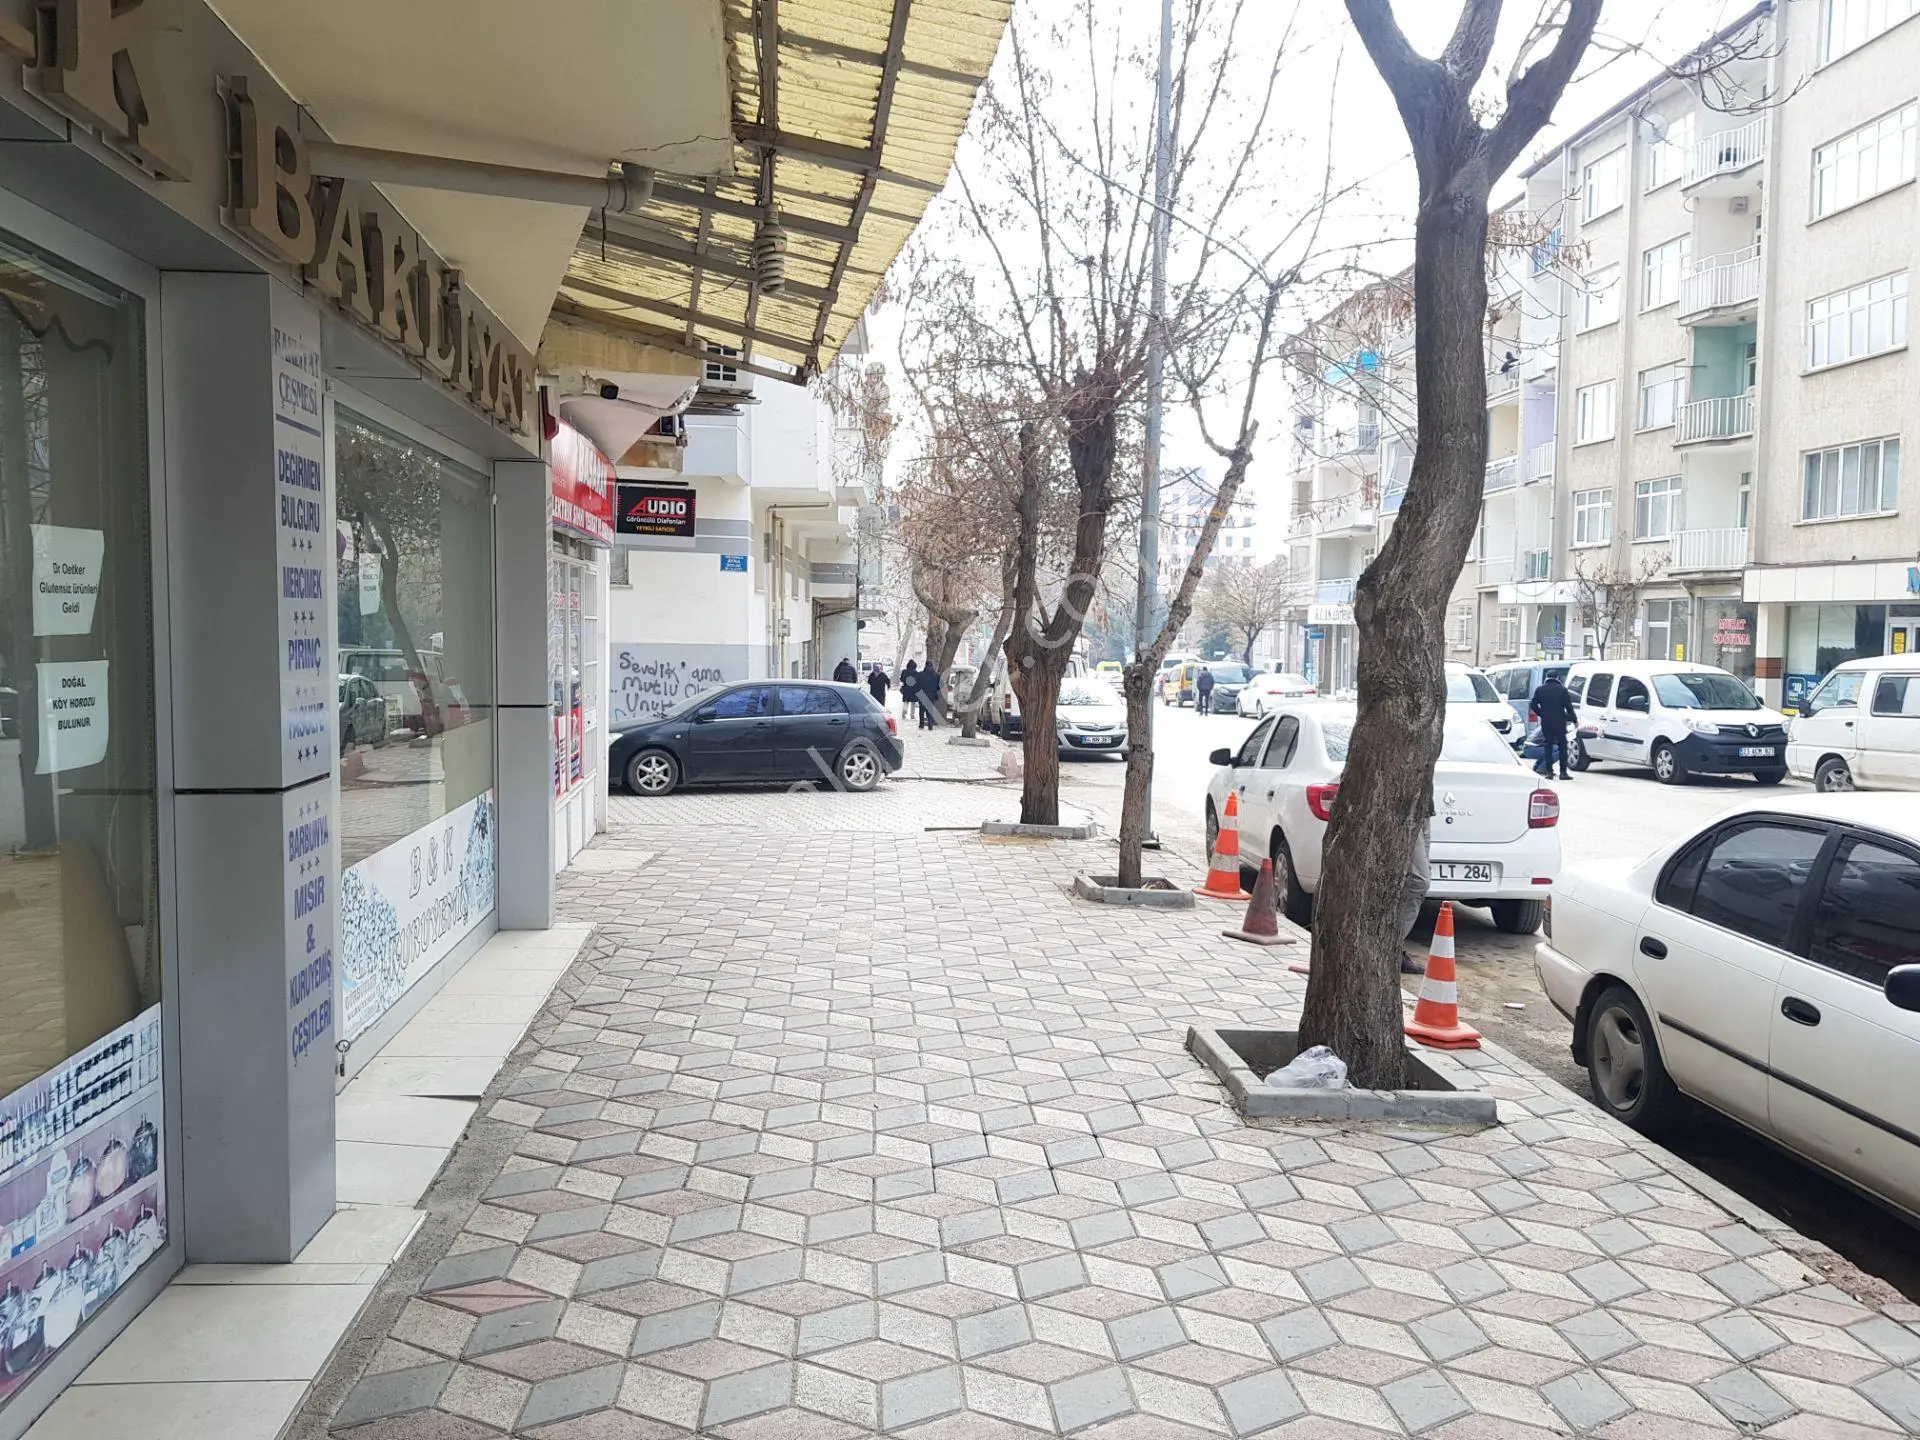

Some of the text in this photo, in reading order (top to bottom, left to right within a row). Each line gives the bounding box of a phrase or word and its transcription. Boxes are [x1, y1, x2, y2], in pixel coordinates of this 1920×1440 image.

[216, 76, 535, 436] BAKLİYAT
[279, 371, 318, 415] ÇEŞMESİ
[278, 446, 321, 492] DEĞİRMEN
[281, 494, 320, 533] BULGURU
[628, 497, 688, 517] AUDIO
[39, 581, 72, 594] Glutensiz
[62, 562, 86, 576] Oetker
[282, 558, 323, 600] MERCİMEK
[62, 601, 80, 614] Geldi
[287, 629, 321, 676] PİRİNÇ
[62, 675, 86, 688] DOĞAL
[53, 696, 96, 710] KÖY HOROZU
[57, 716, 91, 730] BULUNUR
[288, 815, 329, 862] BARBUNYA
[409, 846, 422, 900] B
[426, 836, 439, 887] &
[1439, 864, 1489, 880] LT 284
[294, 875, 325, 920] MISIR
[305, 923, 316, 953] &
[289, 947, 332, 1010] KURUYEMİŞ
[291, 991, 332, 1067] ÇEŞİTLERİ
